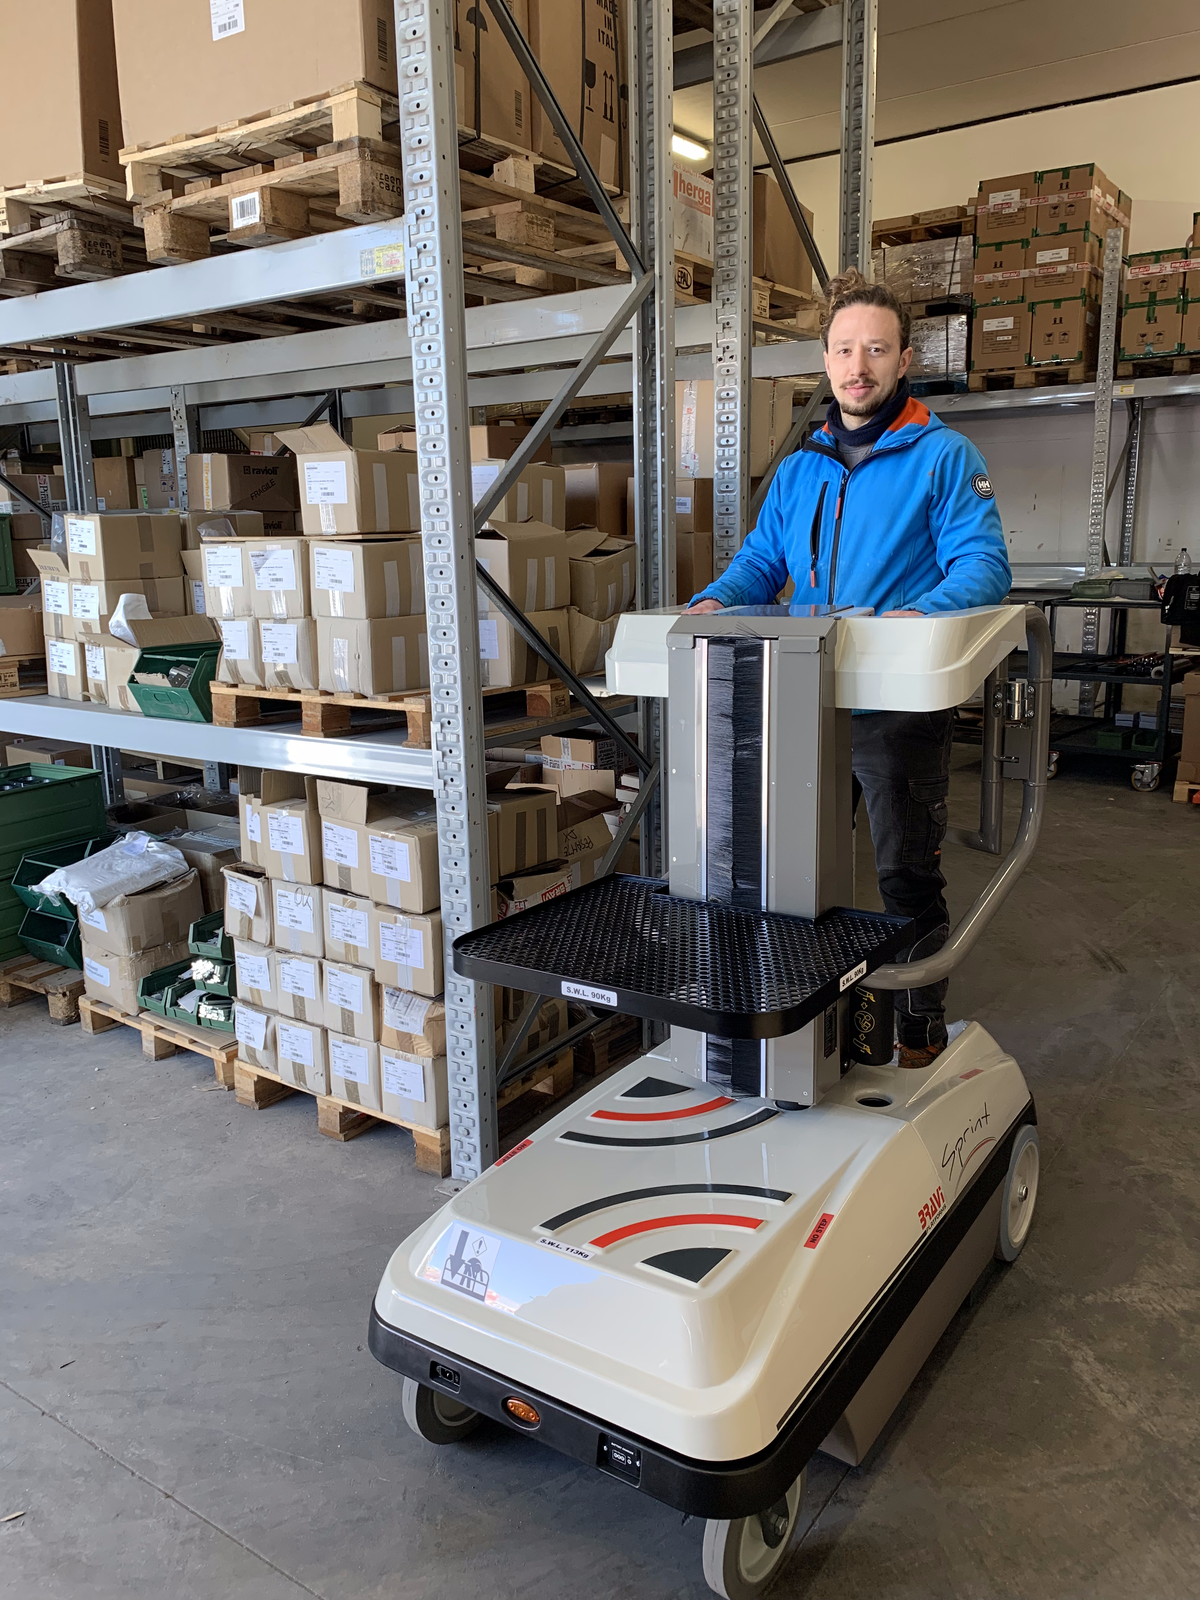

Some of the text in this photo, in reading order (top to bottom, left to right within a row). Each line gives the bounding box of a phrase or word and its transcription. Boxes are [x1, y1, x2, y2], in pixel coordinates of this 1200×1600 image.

[604, 14, 612, 31] IN
[598, 28, 615, 51] ITAL
[376, 172, 401, 184] reen
[379, 181, 403, 197] carg
[679, 172, 711, 206] herga
[252, 466, 279, 475] ravioli
[250, 479, 276, 500] FRAGILE
[264, 521, 283, 530] avioli
[566, 986, 611, 1003] S.W.L. 90Kg
[941, 1102, 990, 1181] Sprint
[809, 1218, 828, 1243] NO STEP
[540, 1239, 589, 1258] S.W.L. 113Kg
